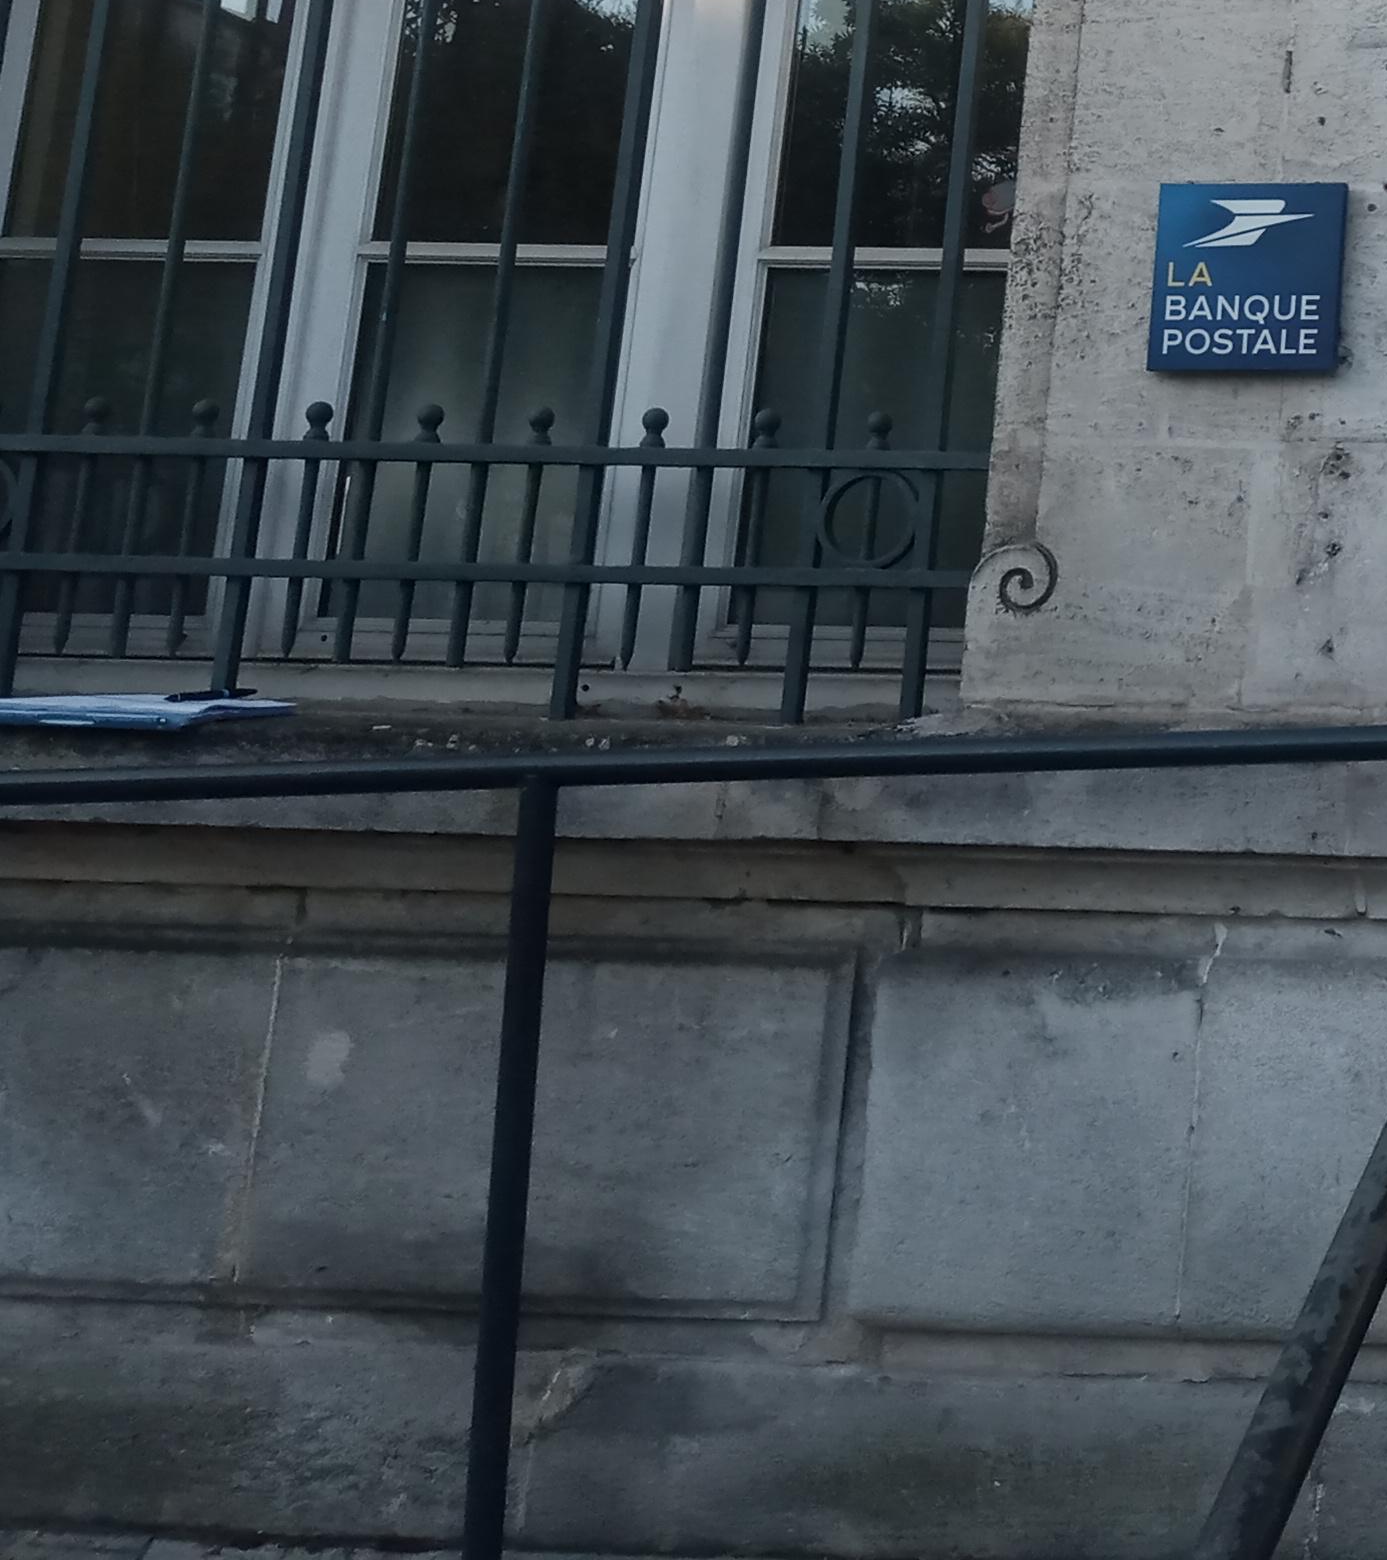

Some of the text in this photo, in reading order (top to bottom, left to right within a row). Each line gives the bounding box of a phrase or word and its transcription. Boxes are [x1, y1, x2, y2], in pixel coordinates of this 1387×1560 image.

[1167, 262, 1212, 287] LA
[1164, 295, 1320, 324] BANQUE
[1162, 329, 1318, 355] POSTALE
